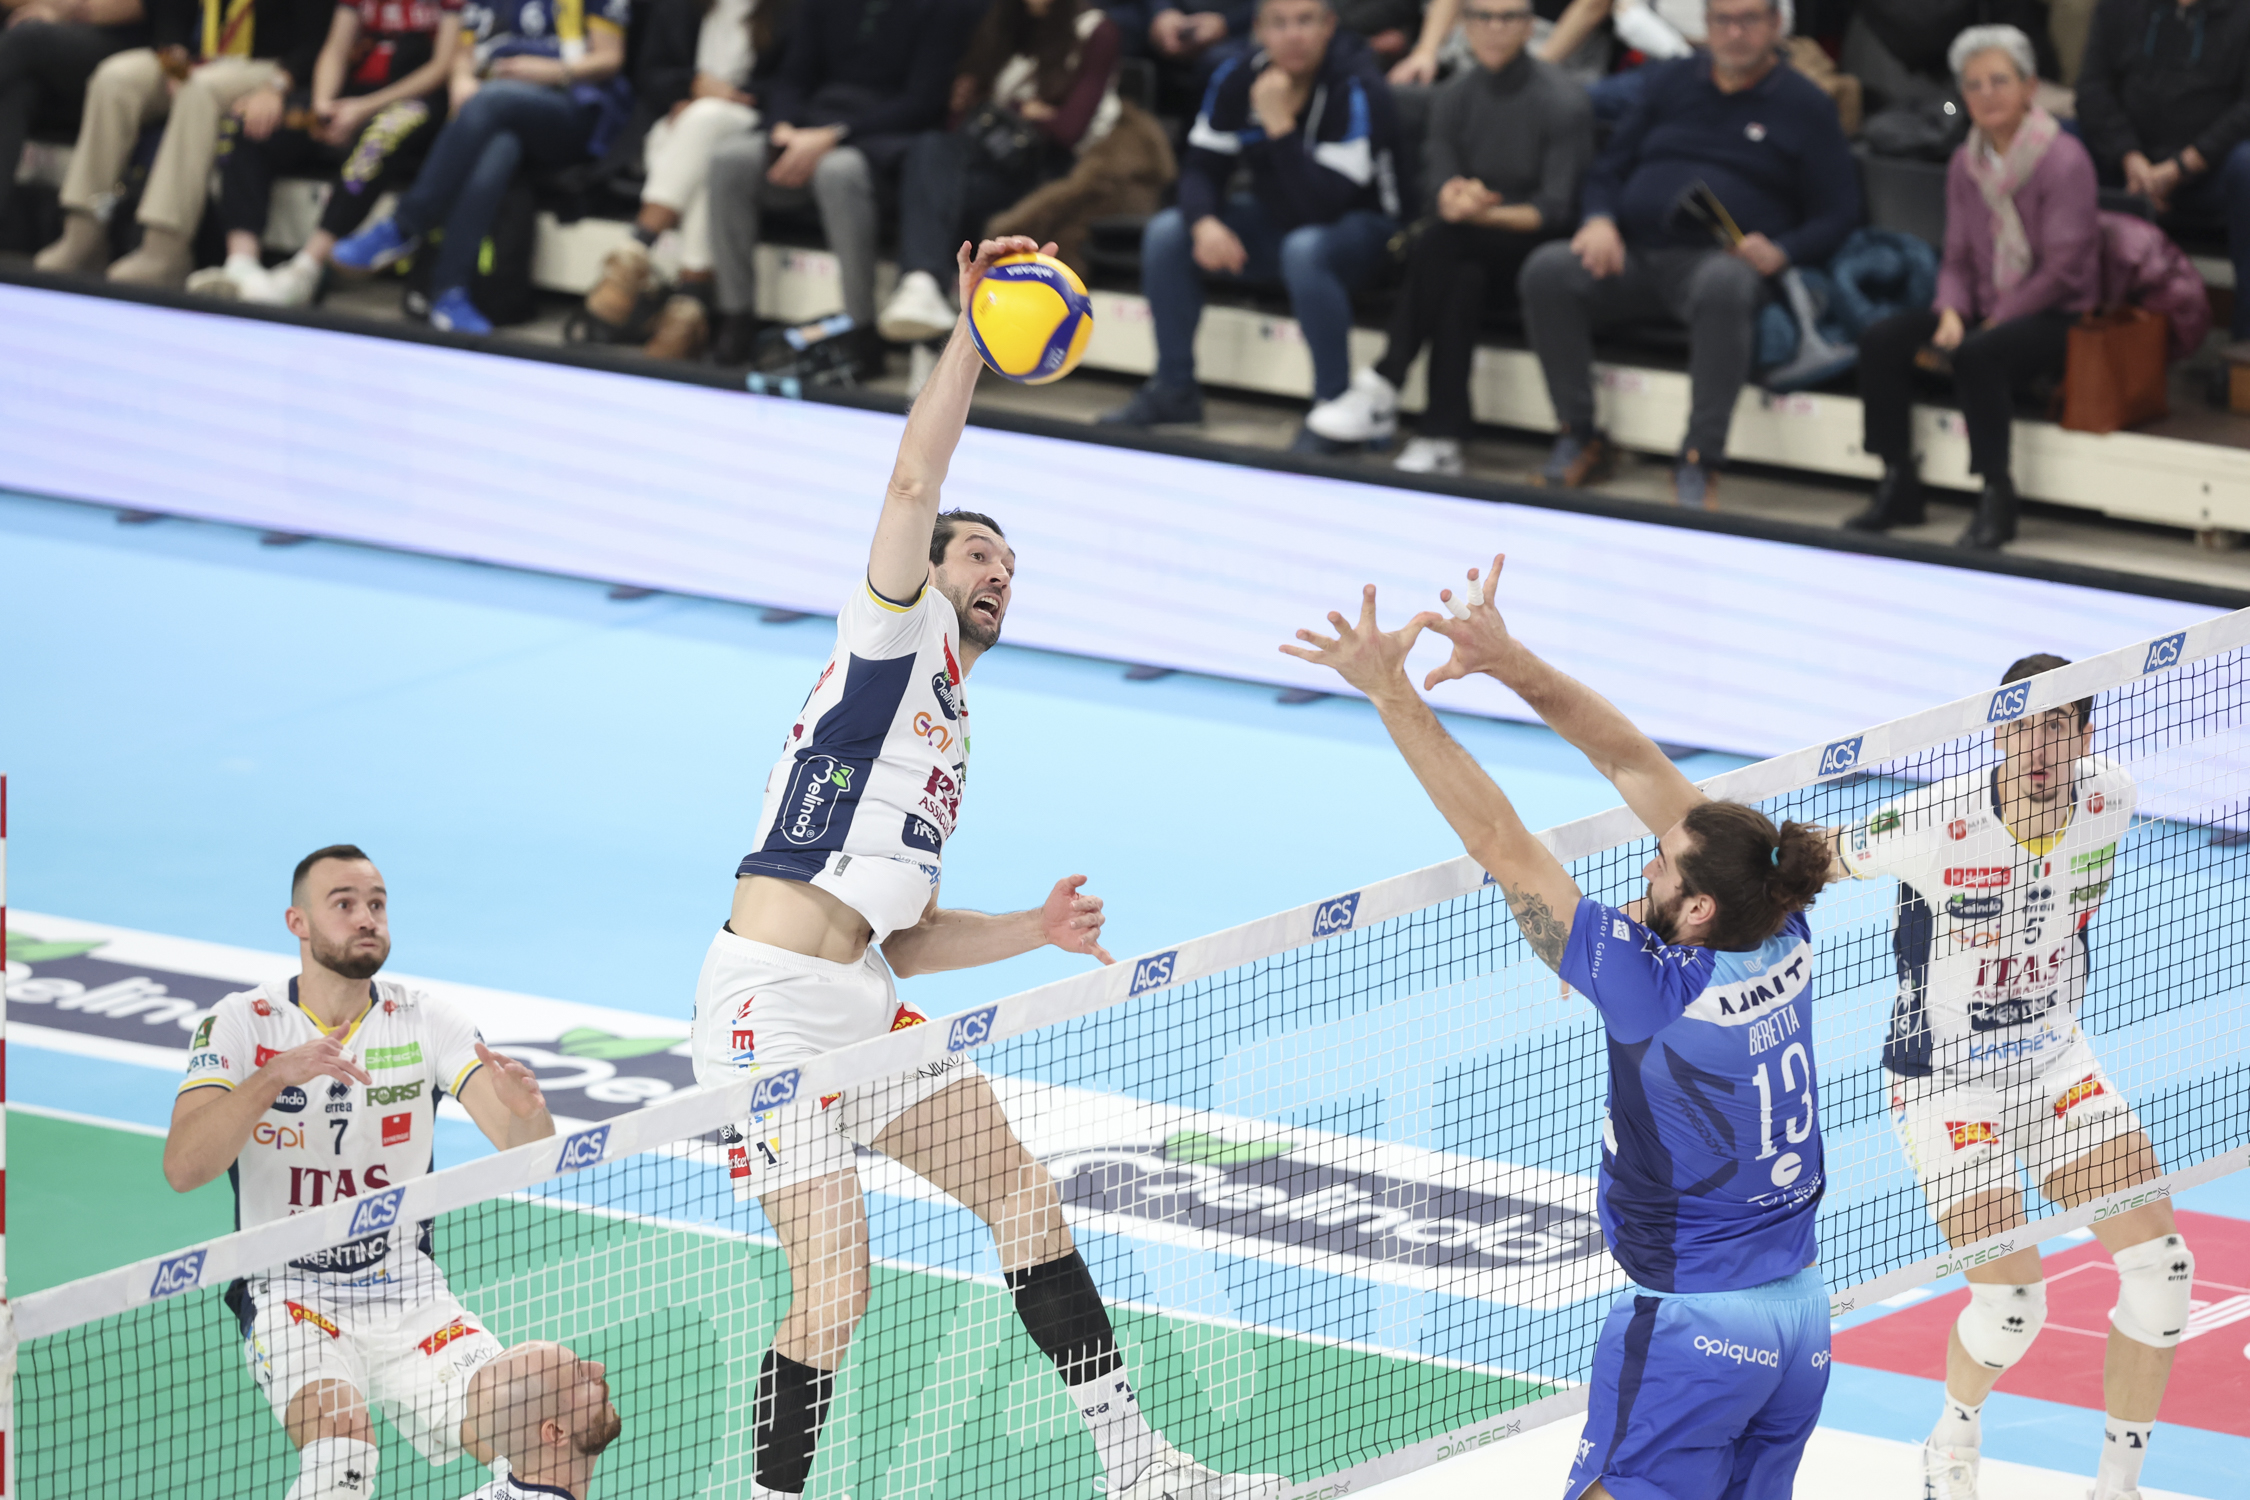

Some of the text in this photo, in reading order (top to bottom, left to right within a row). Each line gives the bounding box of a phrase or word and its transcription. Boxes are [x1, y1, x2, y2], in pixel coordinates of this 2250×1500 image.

[2147, 637, 2179, 670] ACS
[1989, 687, 2027, 720] ACS
[1821, 739, 1857, 775] ACS
[791, 759, 834, 838] Melinda
[1315, 899, 1356, 939] ACS
[2024, 917, 2044, 944] 5
[1133, 954, 1173, 992] ACS
[1591, 942, 1605, 979] Goloso
[952, 1009, 994, 1049] ACS
[1749, 1003, 1800, 1056] BERETTA
[366, 1079, 425, 1107] FORST
[753, 1076, 796, 1108] ACS
[1752, 1041, 1813, 1161] 13
[253, 1121, 304, 1150] Gpi
[329, 1119, 348, 1155] 7
[560, 1130, 604, 1169] ACS
[352, 1192, 398, 1234] ACS
[154, 1253, 200, 1293] ACS
[1693, 1335, 1779, 1368] opiquad
